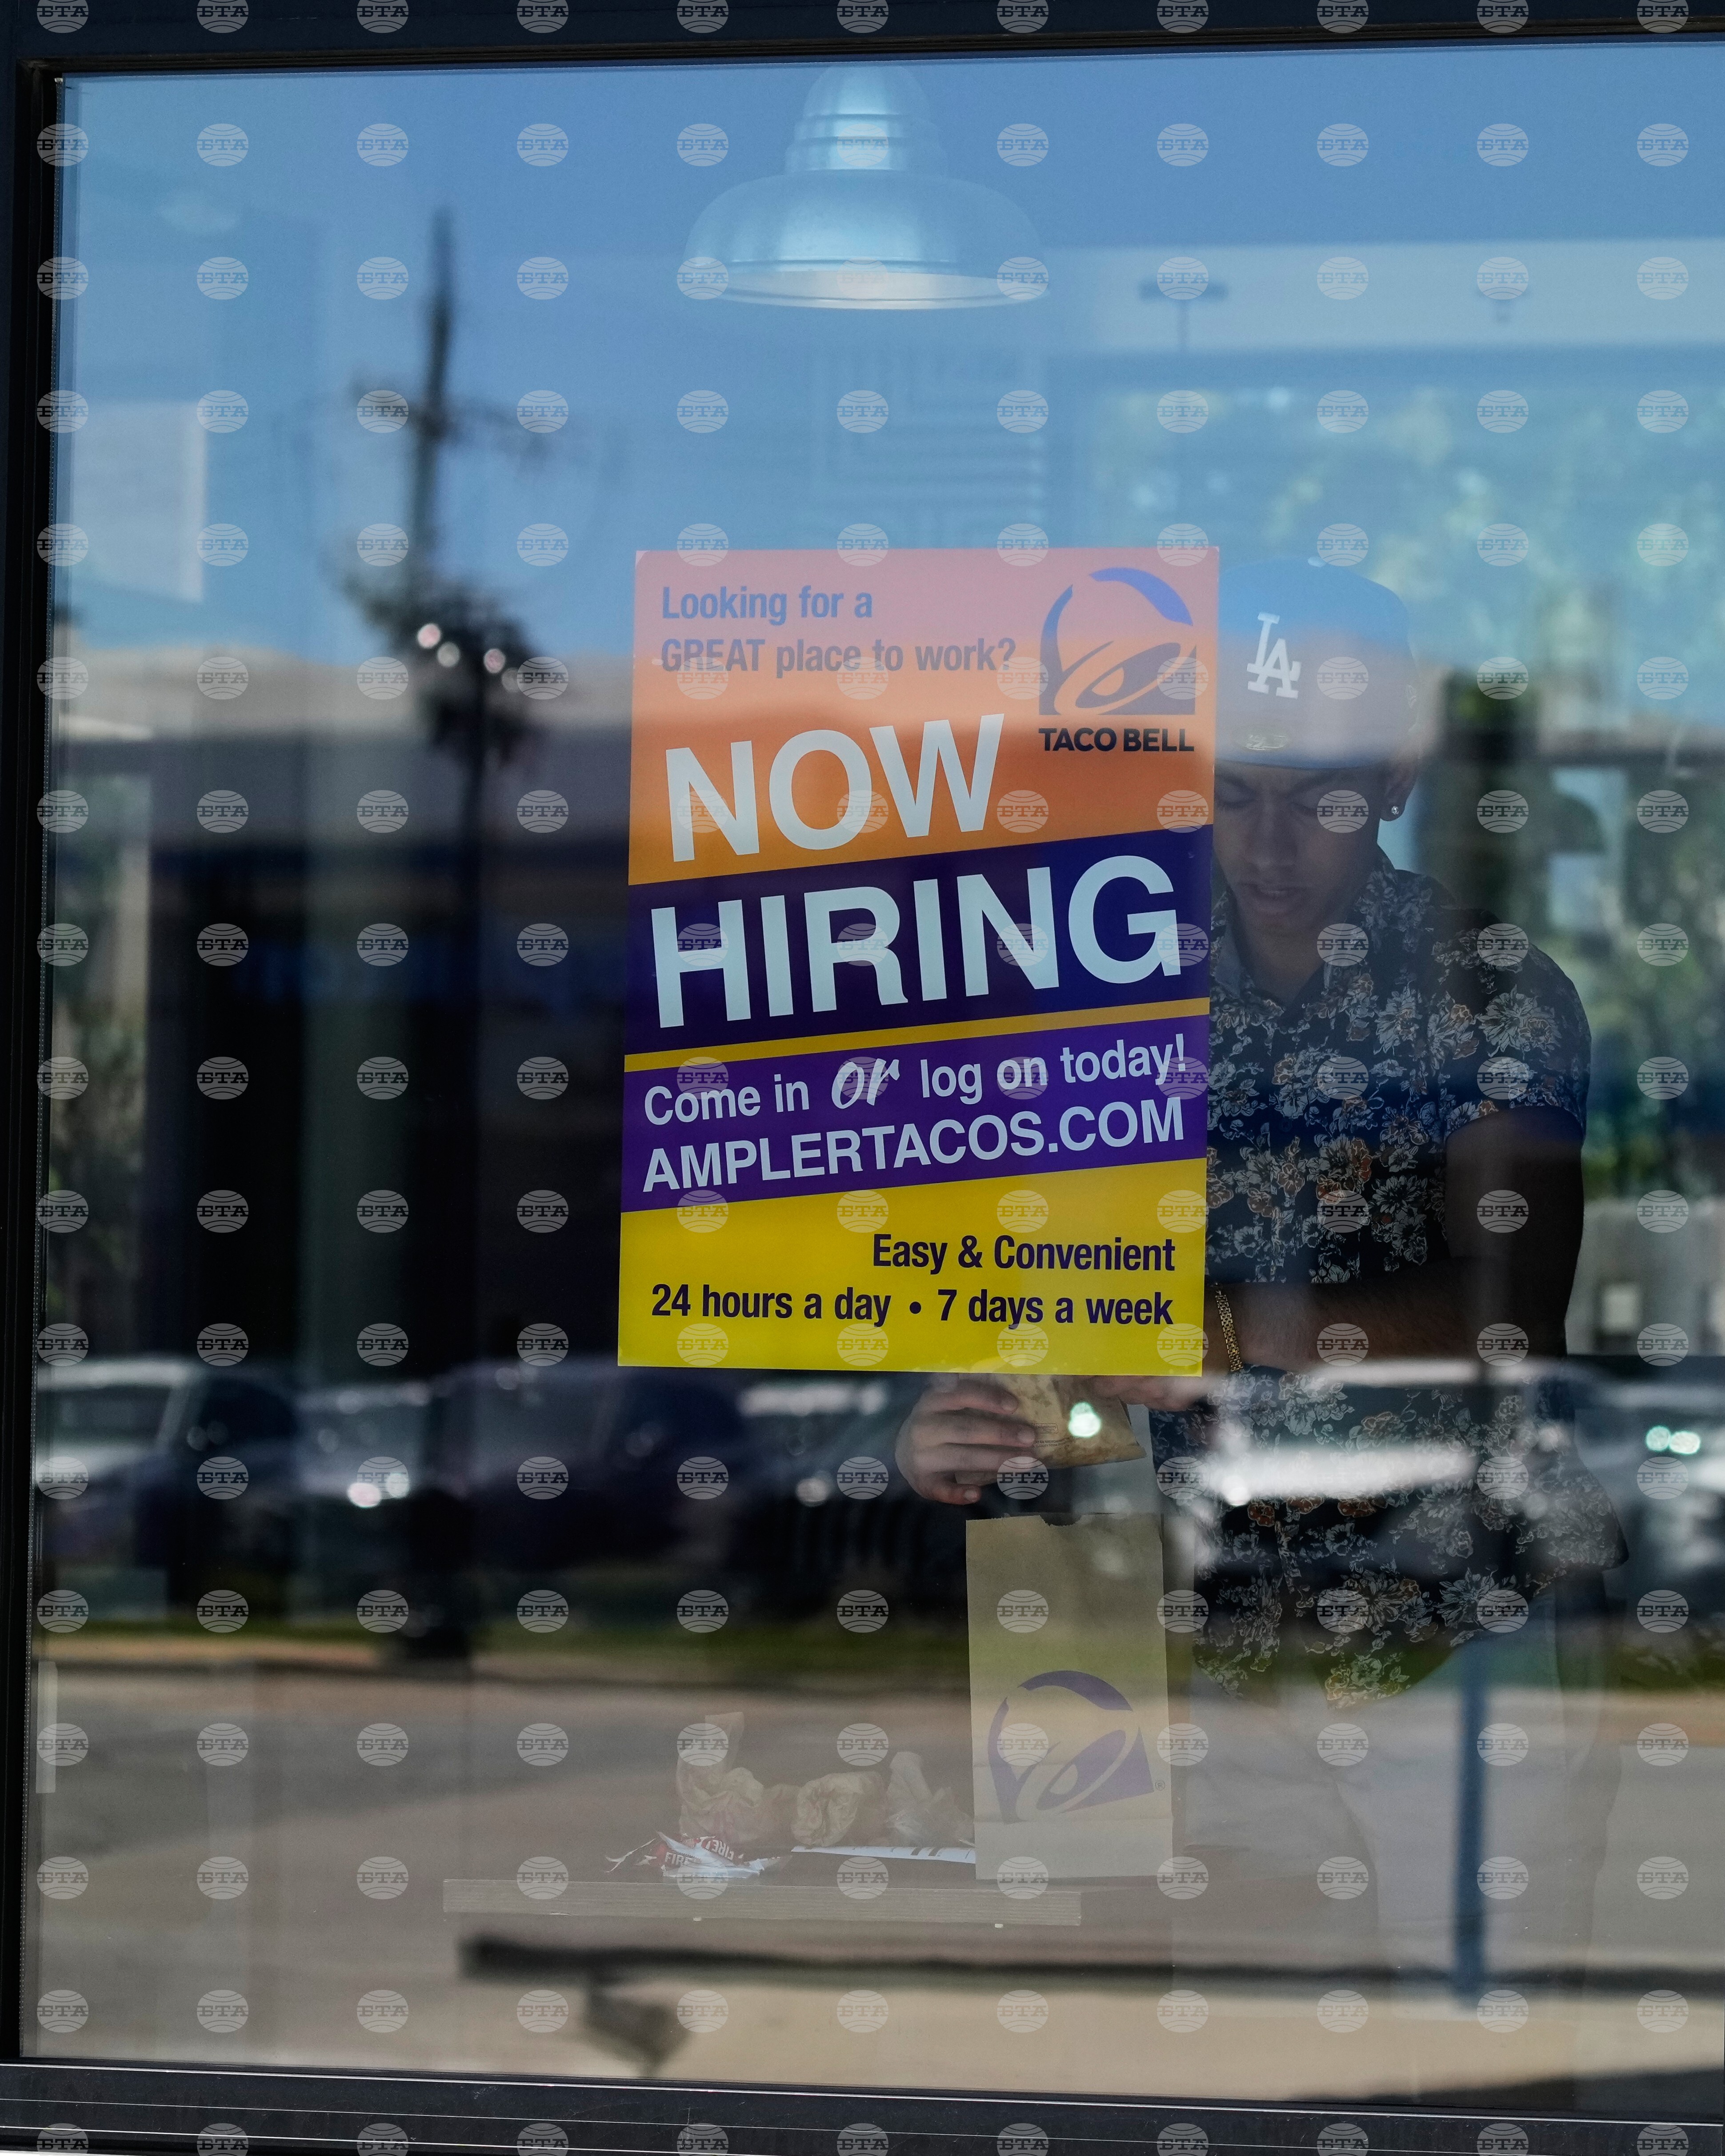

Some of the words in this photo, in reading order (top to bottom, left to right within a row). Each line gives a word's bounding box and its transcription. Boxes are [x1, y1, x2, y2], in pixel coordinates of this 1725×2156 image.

[662, 586, 787, 626] Looking
[799, 585, 844, 618] for
[855, 592, 873, 618] a
[662, 639, 765, 672] GREAT
[776, 639, 861, 679] place
[872, 639, 903, 671] to
[915, 637, 1016, 671] work?
[1247, 612, 1302, 699] LA
[1038, 727, 1117, 752] TACO
[1123, 728, 1195, 752] BELL
[665, 713, 1005, 862] NOW
[651, 855, 1182, 1028] HIRING
[644, 1086, 761, 1126] Come
[774, 1074, 810, 1113] in
[831, 1058, 900, 1109] or
[921, 1059, 983, 1105] log
[997, 1057, 1048, 1090] on
[1060, 1033, 1187, 1086] today!
[643, 1096, 1185, 1193] AMPLERTACOS.COM
[873, 1234, 948, 1275] Easy
[958, 1235, 983, 1268] &
[994, 1235, 1176, 1271] Convenient
[652, 1284, 691, 1316] 24
[702, 1284, 792, 1319] hours
[804, 1293, 822, 1319] a
[834, 1286, 892, 1328] day
[938, 1289, 957, 1321] 7
[968, 1289, 1043, 1330] days
[1055, 1297, 1073, 1323] a
[1085, 1291, 1174, 1325] week
